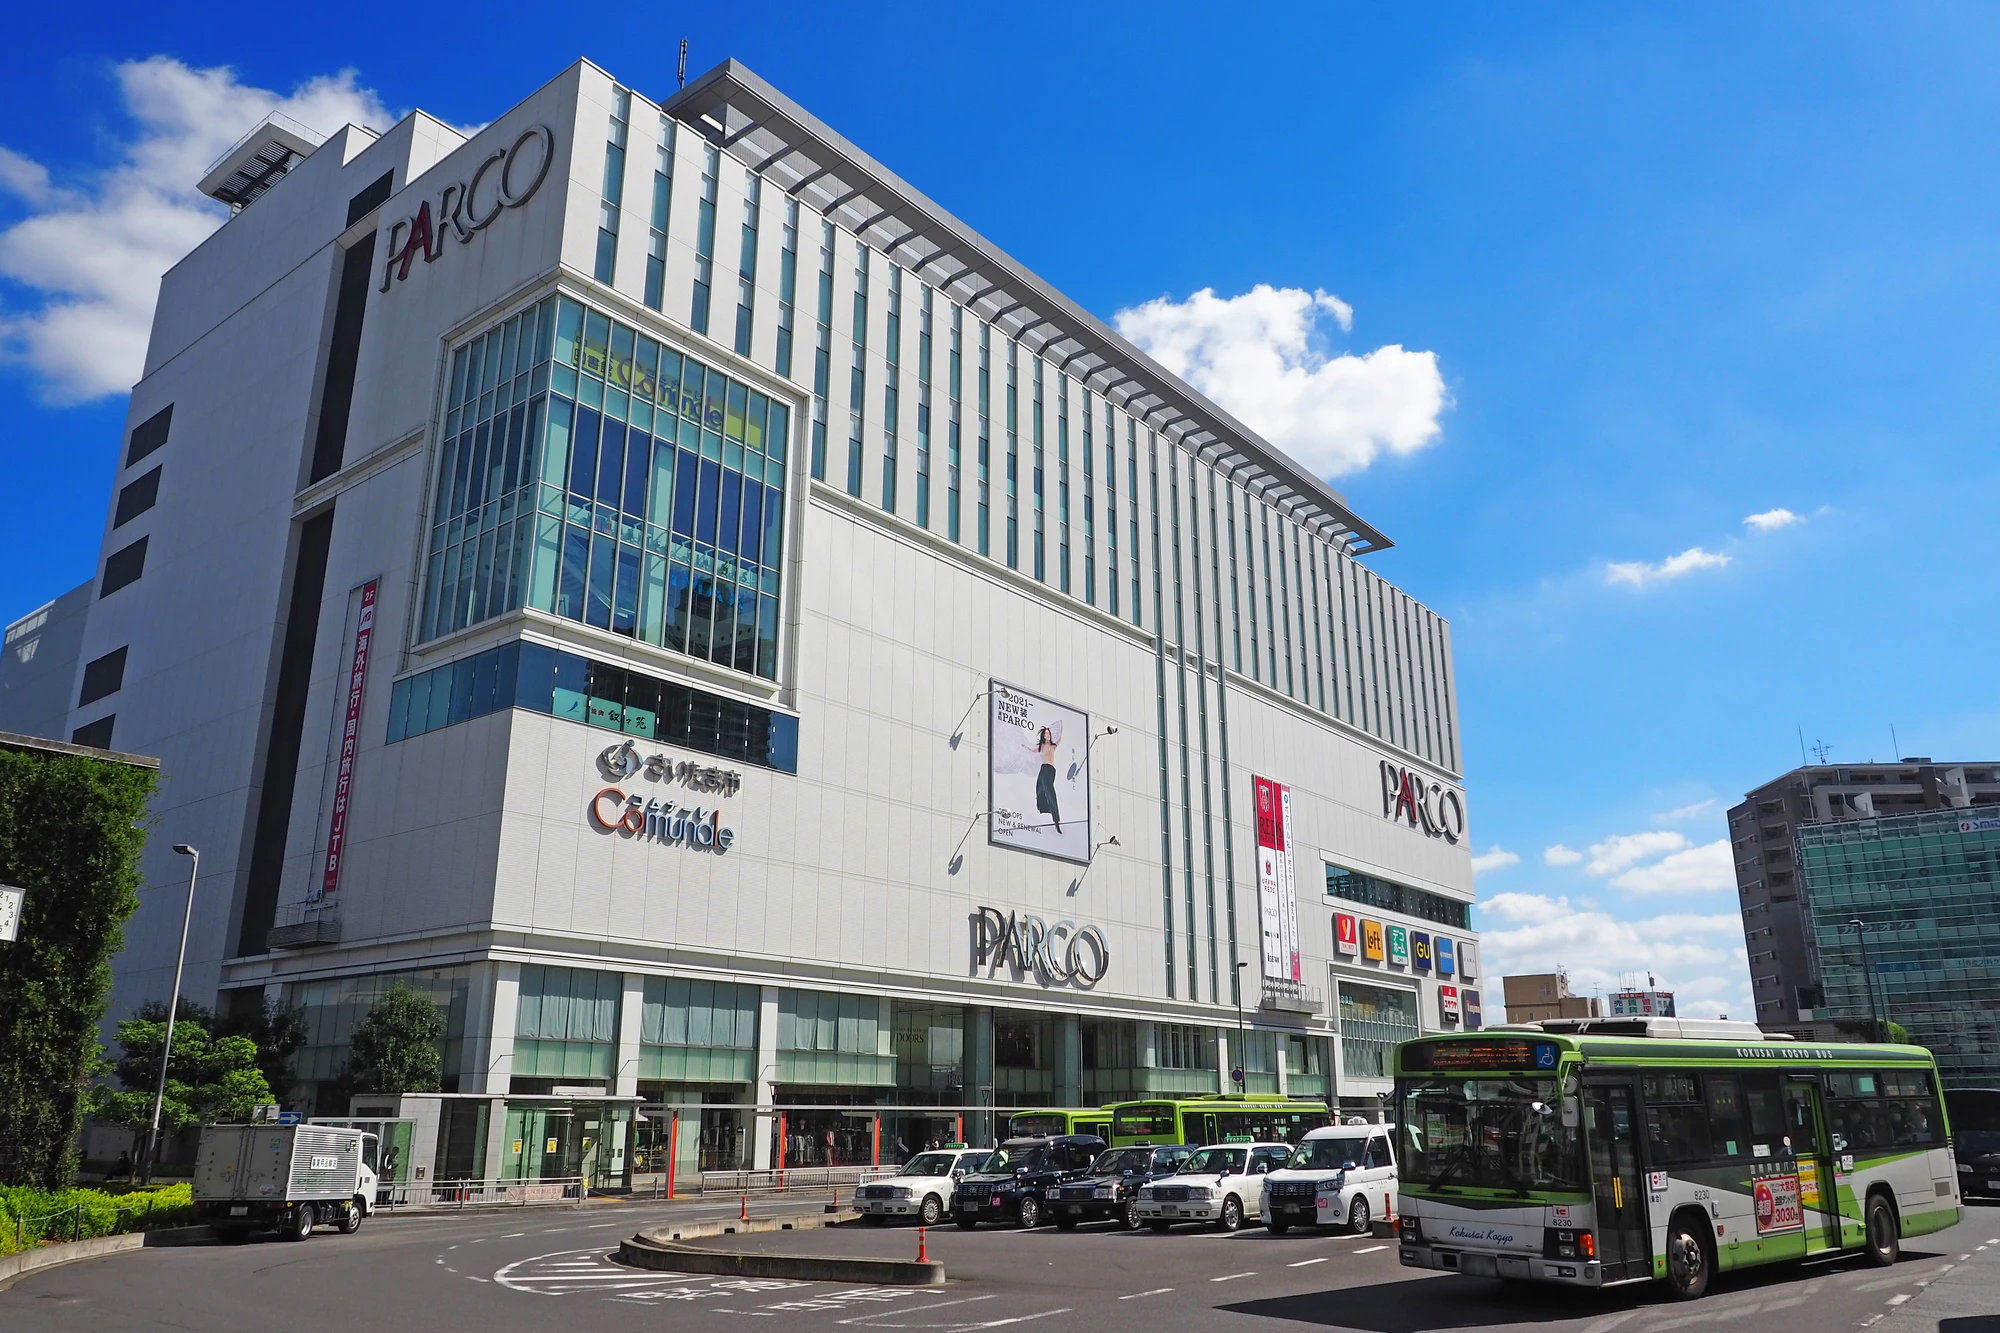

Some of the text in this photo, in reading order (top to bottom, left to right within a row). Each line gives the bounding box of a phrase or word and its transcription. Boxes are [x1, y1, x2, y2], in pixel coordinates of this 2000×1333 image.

[379, 124, 554, 293] PARCO
[364, 590, 374, 603] 2F
[1380, 759, 1465, 841] PARCO
[594, 787, 735, 849] Comunale
[998, 817, 1012, 827] NEW
[998, 827, 1014, 837] OPEN
[8, 902, 14, 910] 2
[8, 911, 14, 919] 3
[1842, 922, 1914, 934] カラオケ
[977, 906, 1110, 982] PARCO
[1416, 942, 1430, 959] GU
[896, 1032, 924, 1043] DOORS
[1736, 1048, 1833, 1059] KOKUSAI KOGYO BUS
[1694, 1189, 1710, 1201] 8230
[1552, 1219, 1572, 1228] 8230
[1486, 1229, 1514, 1246] Kogyo
